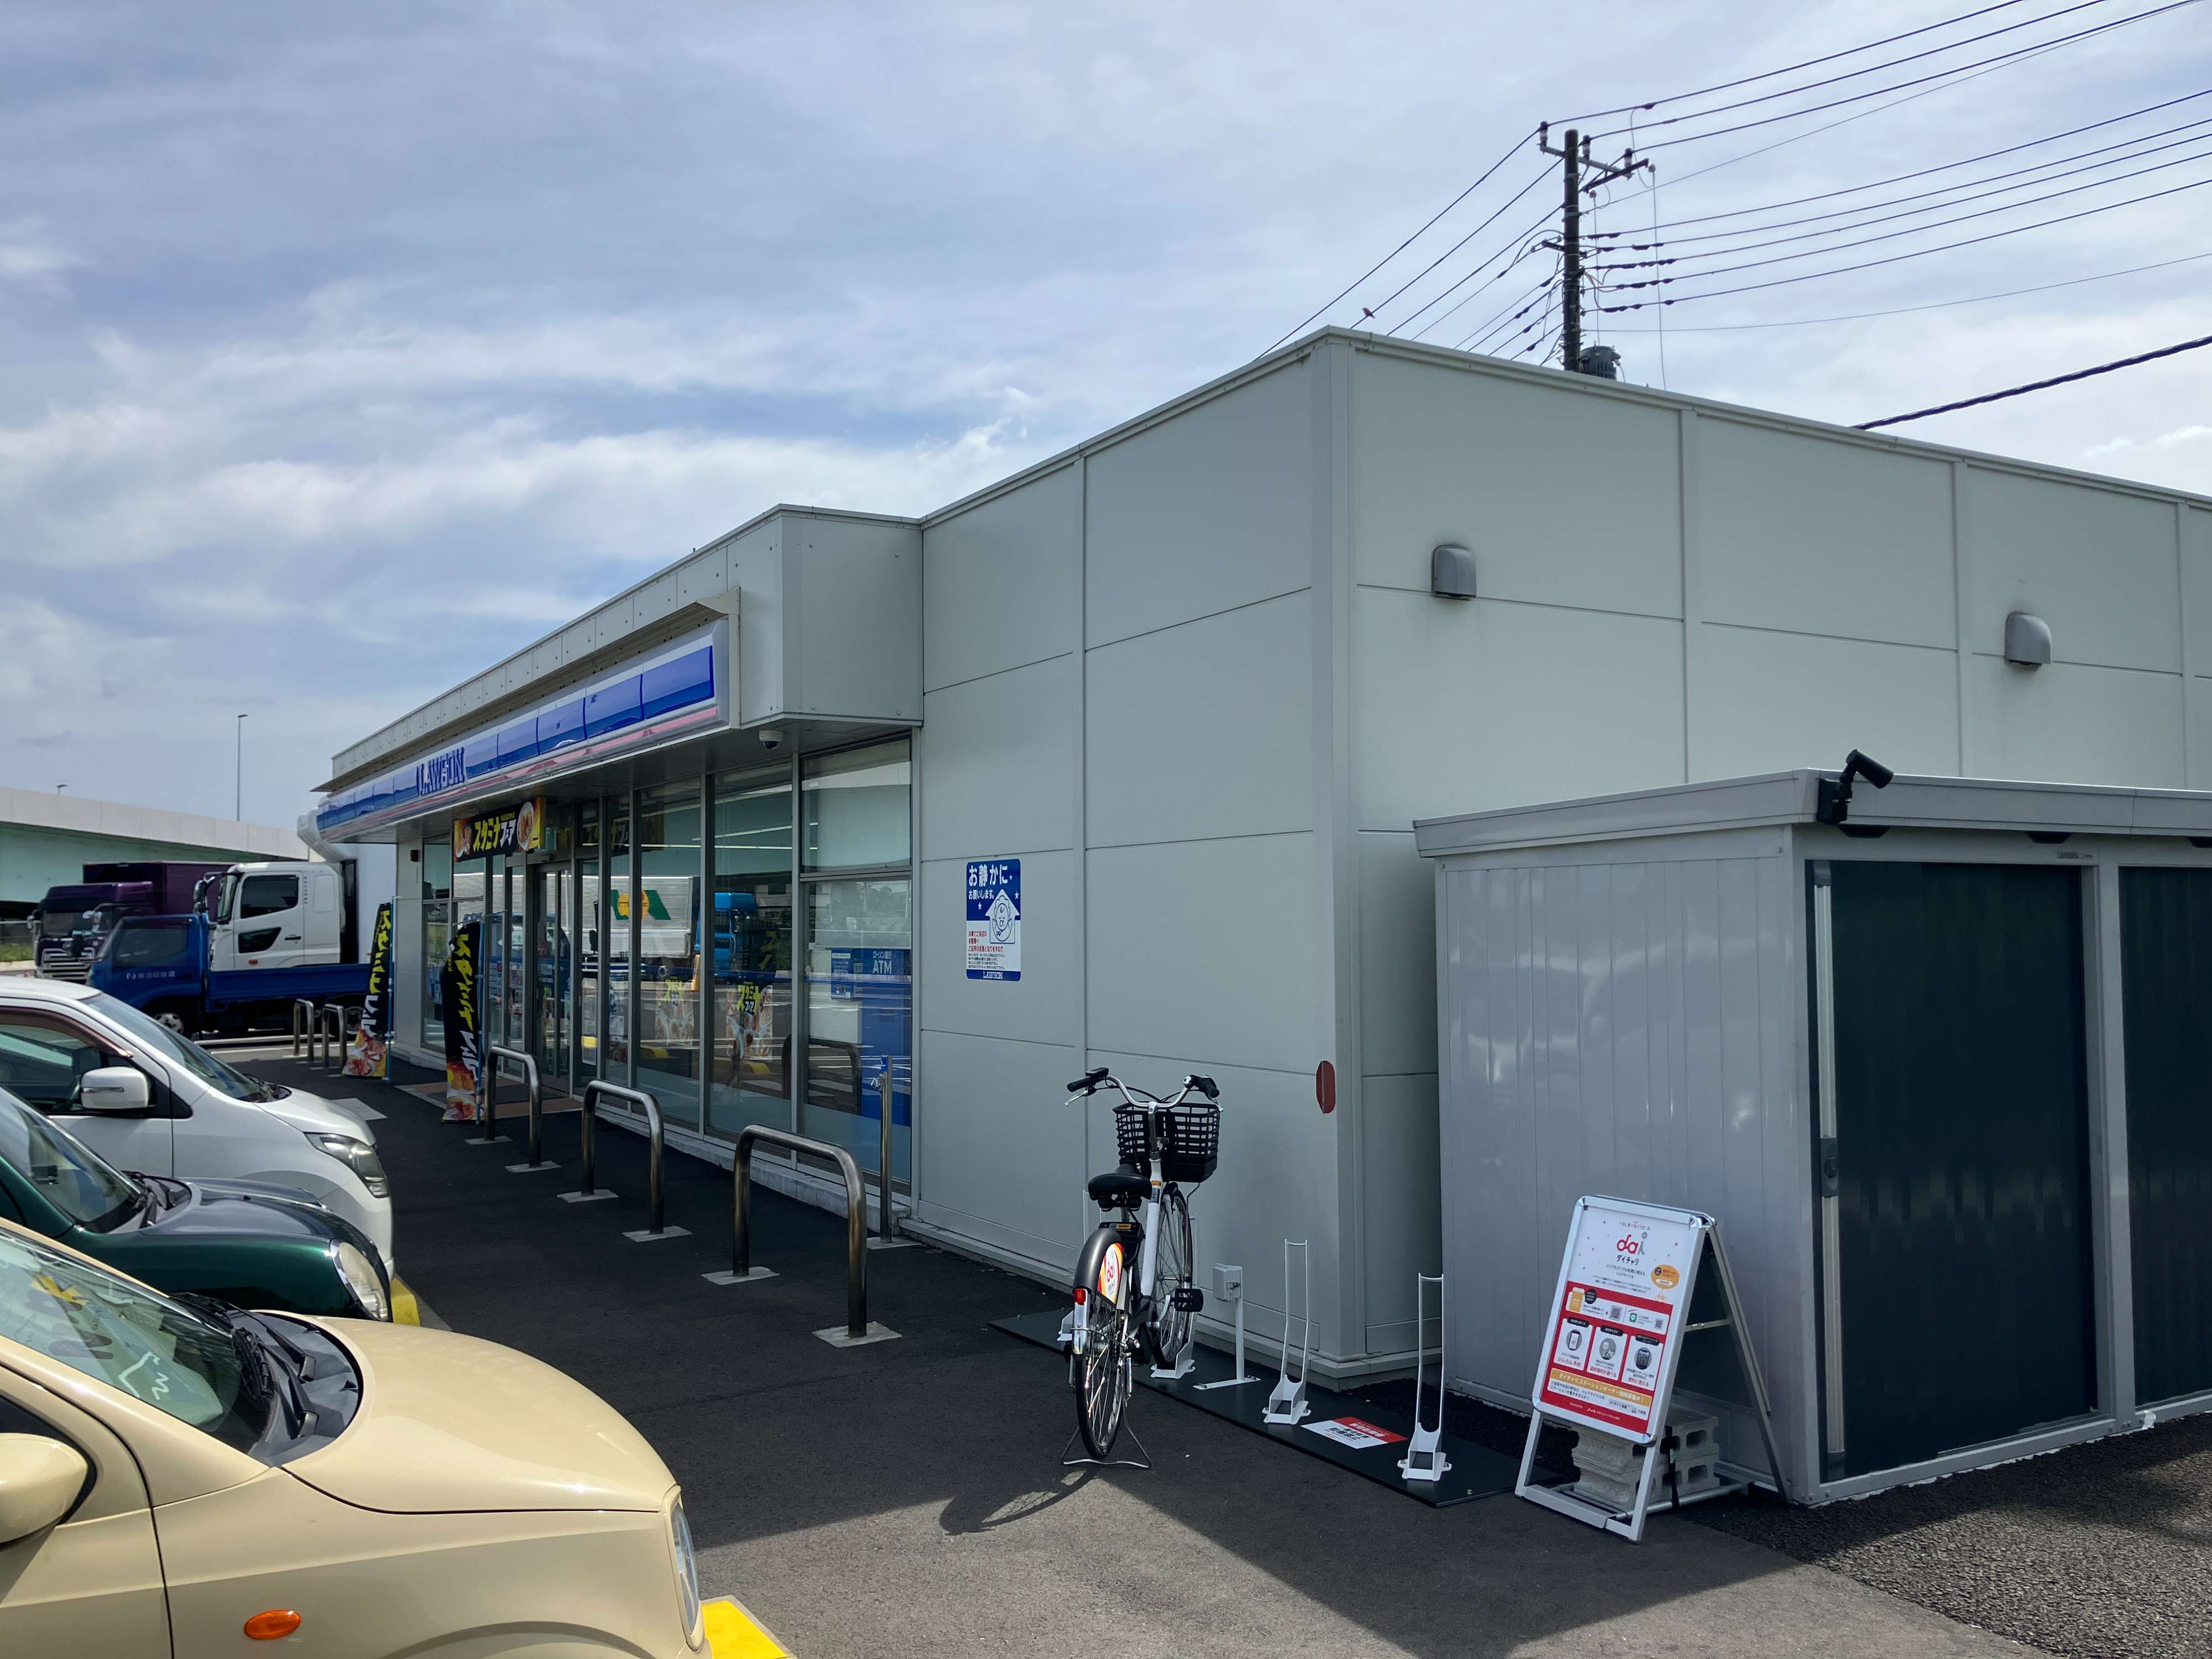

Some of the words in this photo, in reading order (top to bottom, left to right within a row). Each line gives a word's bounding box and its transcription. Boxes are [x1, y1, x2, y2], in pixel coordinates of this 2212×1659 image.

[420, 747, 466, 796] LAWSON
[969, 864, 1008, 887] お静かに
[873, 960, 892, 974] ATM
[983, 971, 1003, 979] LAWSON
[1616, 1255, 1639, 1265] ダイチャリ
[1558, 1357, 1580, 1368] かんたん予約
